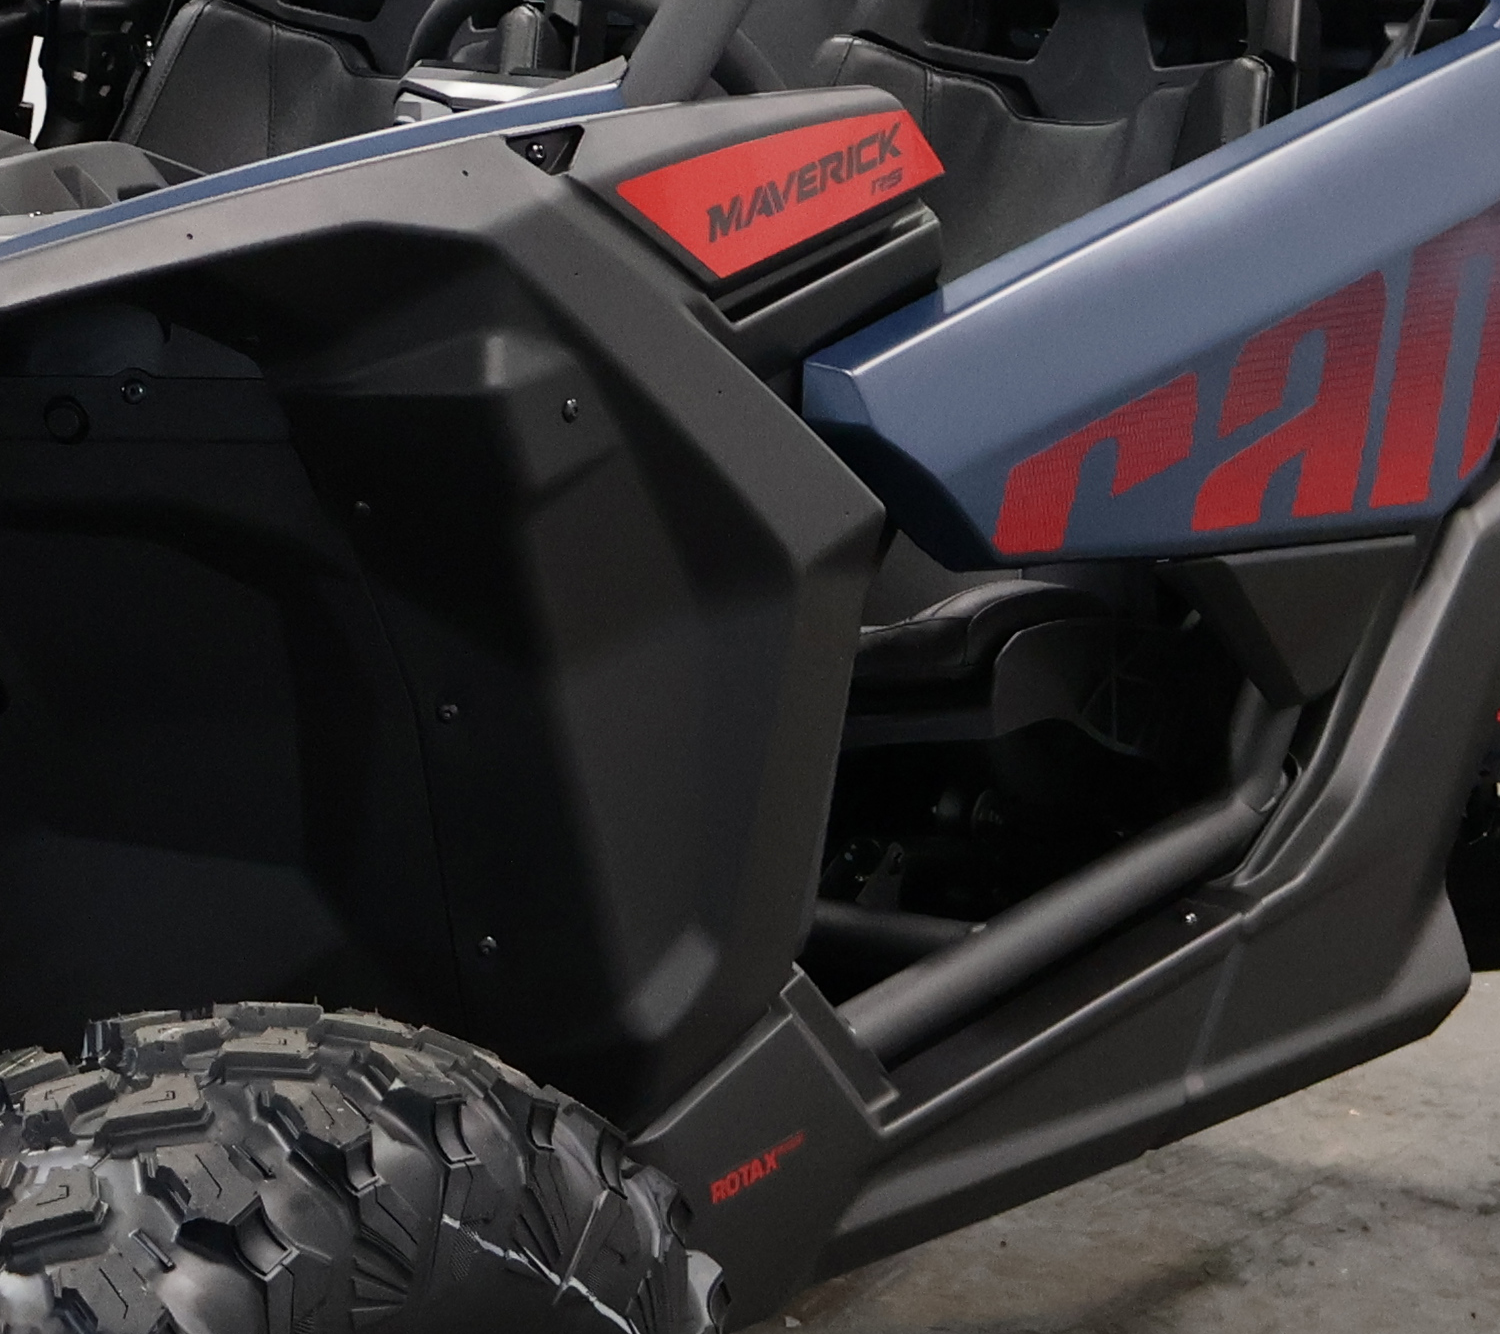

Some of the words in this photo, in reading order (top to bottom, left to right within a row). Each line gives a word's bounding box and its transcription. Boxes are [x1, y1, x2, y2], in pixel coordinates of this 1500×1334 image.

[707, 122, 902, 243] MAVERICK
[871, 168, 903, 196] RS
[710, 1151, 779, 1204] ROTAX
